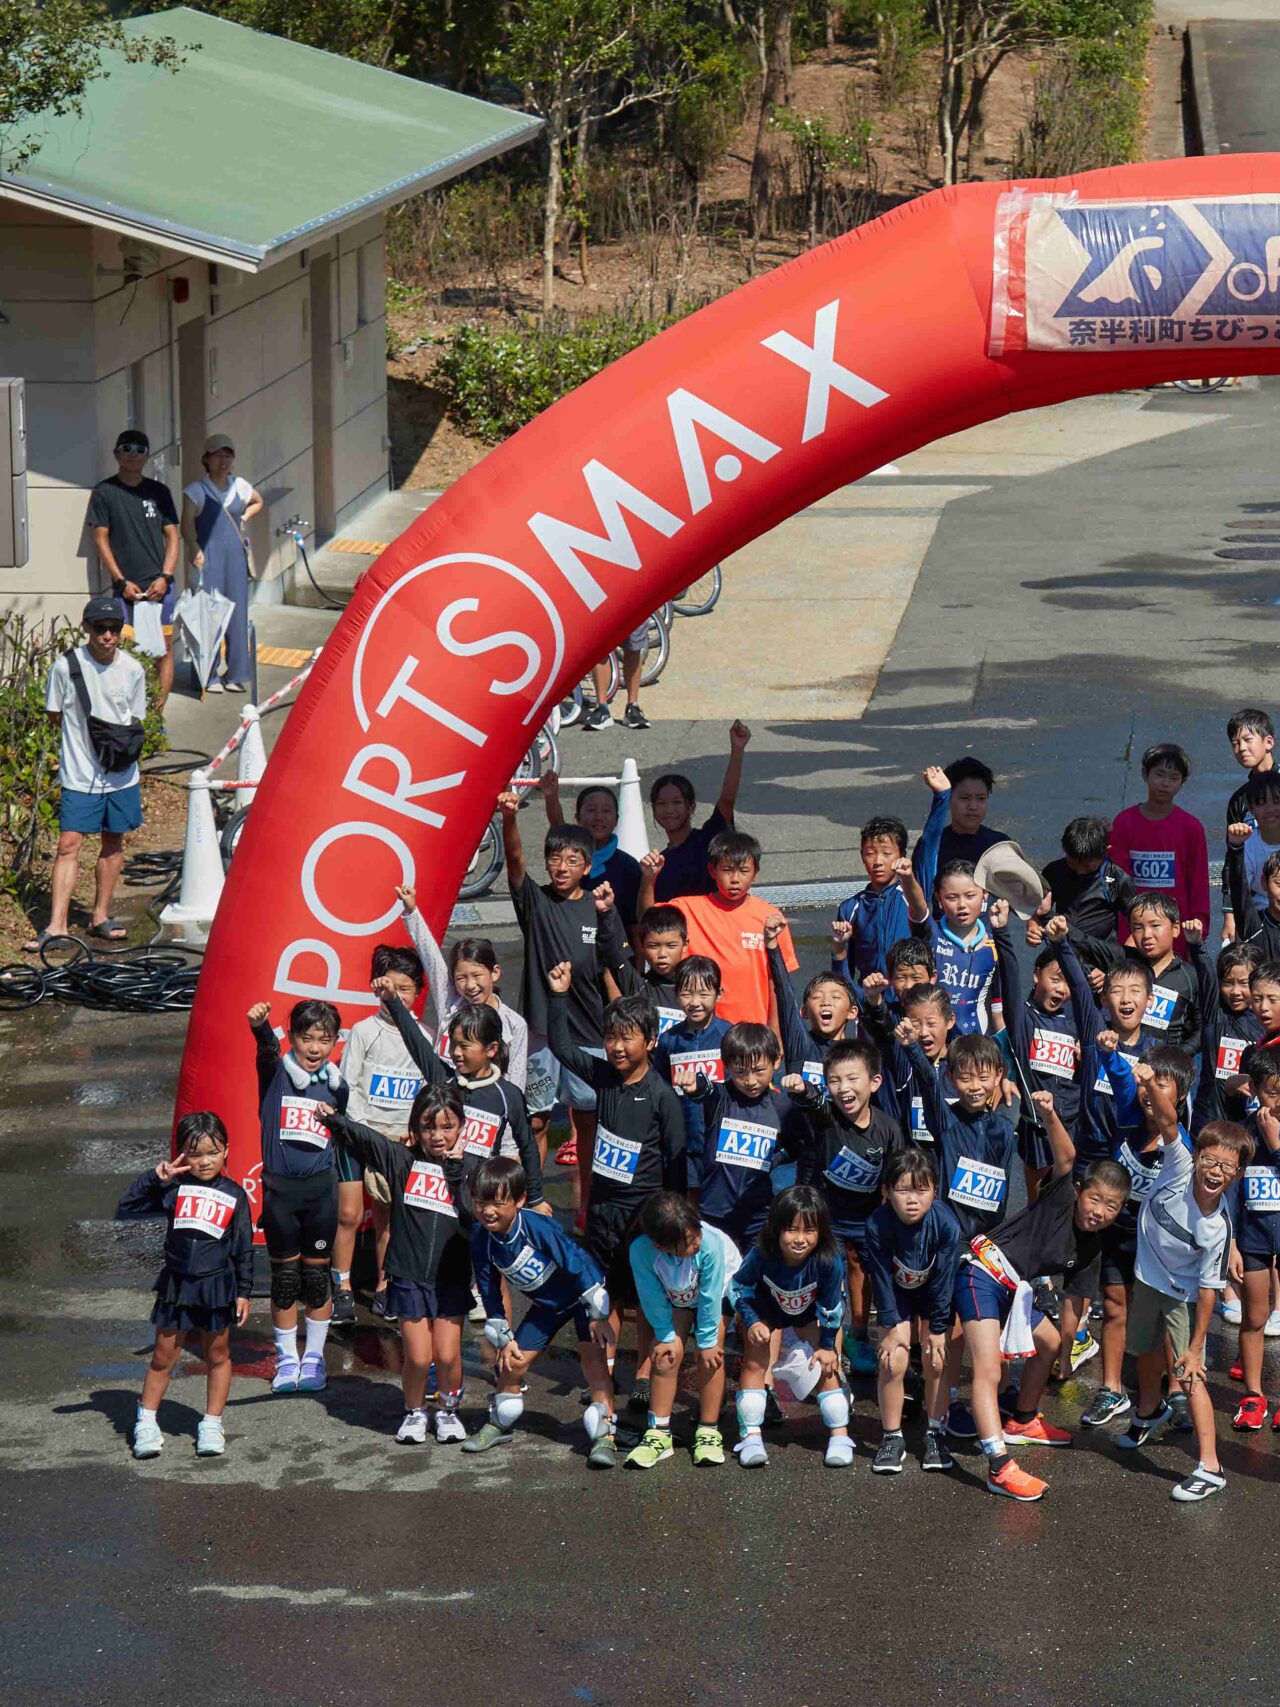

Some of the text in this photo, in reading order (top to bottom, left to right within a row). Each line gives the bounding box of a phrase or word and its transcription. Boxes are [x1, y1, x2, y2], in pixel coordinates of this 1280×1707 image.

[270, 598, 541, 1040] PORTS
[1132, 860, 1169, 878] C602
[939, 962, 980, 989] Rtu
[1035, 1040, 1074, 1068] B306
[374, 1077, 417, 1099] A102
[461, 1117, 493, 1144] 305
[723, 1131, 772, 1160] A210
[410, 1173, 449, 1201] A20
[956, 1170, 1003, 1201] A201
[179, 1197, 227, 1227] A101
